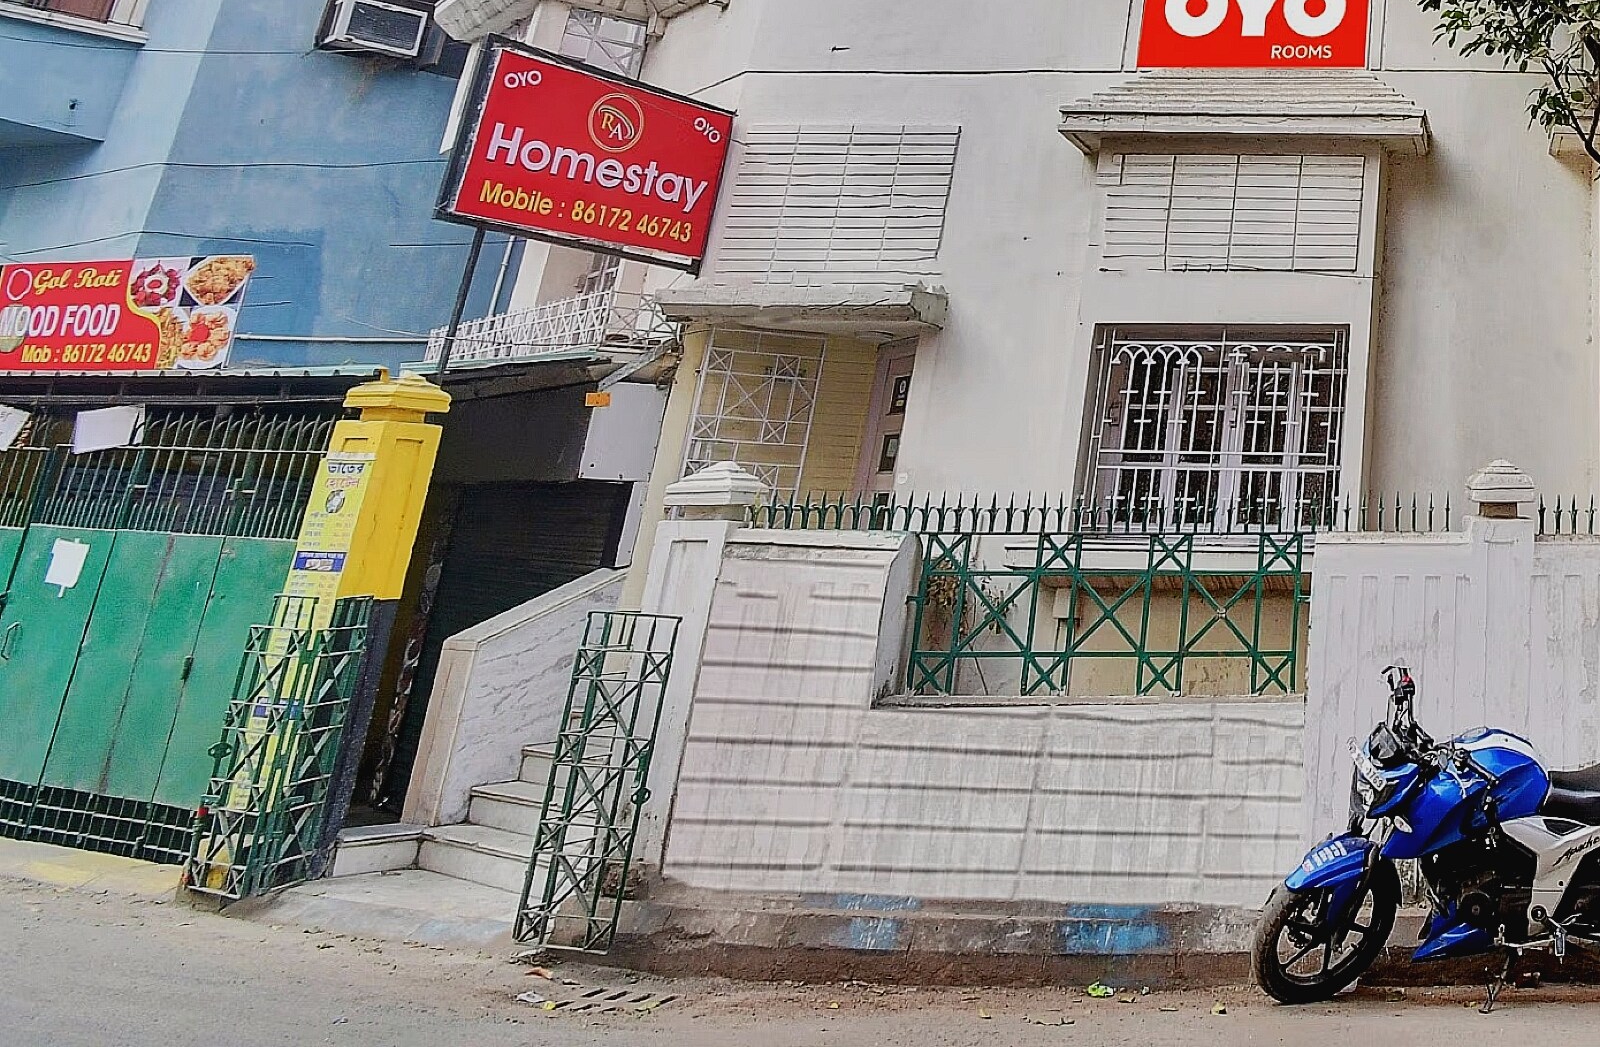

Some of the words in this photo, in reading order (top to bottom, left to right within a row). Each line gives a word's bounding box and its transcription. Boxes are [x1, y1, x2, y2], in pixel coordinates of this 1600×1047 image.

[1270, 45, 1332, 59] ROOMS
[504, 70, 542, 88] OYO
[694, 117, 721, 143] OYO
[486, 123, 708, 212] Homestay
[479, 180, 554, 215] Mobile
[571, 200, 632, 231] 86172
[636, 218, 692, 242] 46743
[33, 269, 73, 295] Gol
[60, 304, 121, 337] FOOD
[21, 345, 52, 362] Mob
[62, 343, 106, 363] 86172
[107, 343, 152, 362] 46743
